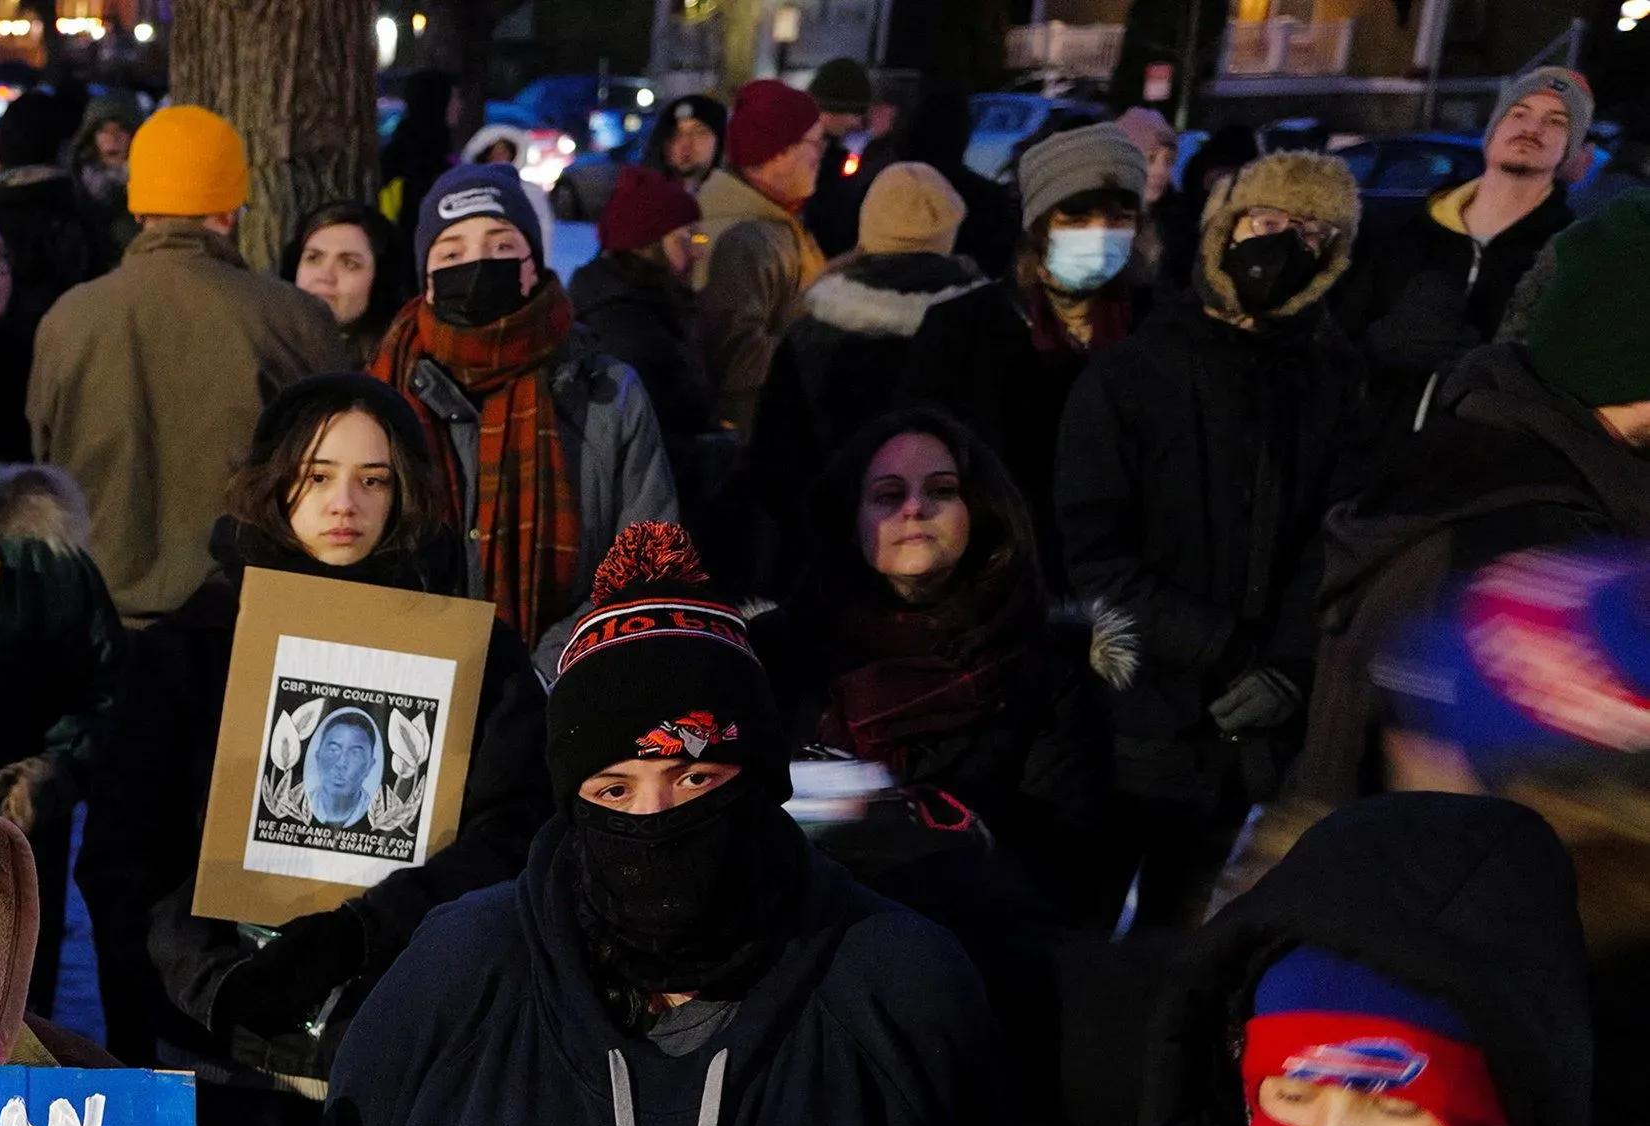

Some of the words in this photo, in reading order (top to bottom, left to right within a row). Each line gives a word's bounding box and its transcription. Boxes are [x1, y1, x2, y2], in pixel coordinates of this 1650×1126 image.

[280, 679, 307, 695] CBP,
[311, 684, 341, 698] HOW
[343, 688, 385, 704] COULD
[387, 695, 413, 709] YOU
[416, 699, 437, 712] ???
[258, 819, 276, 831] WE
[279, 822, 332, 838] DEMAND
[335, 829, 386, 846] JUSTICE
[389, 837, 414, 850] FOR
[259, 829, 300, 844] NURUL
[304, 835, 336, 848] AMIN
[339, 839, 373, 854] SHAH
[375, 845, 410, 858] ALAM
